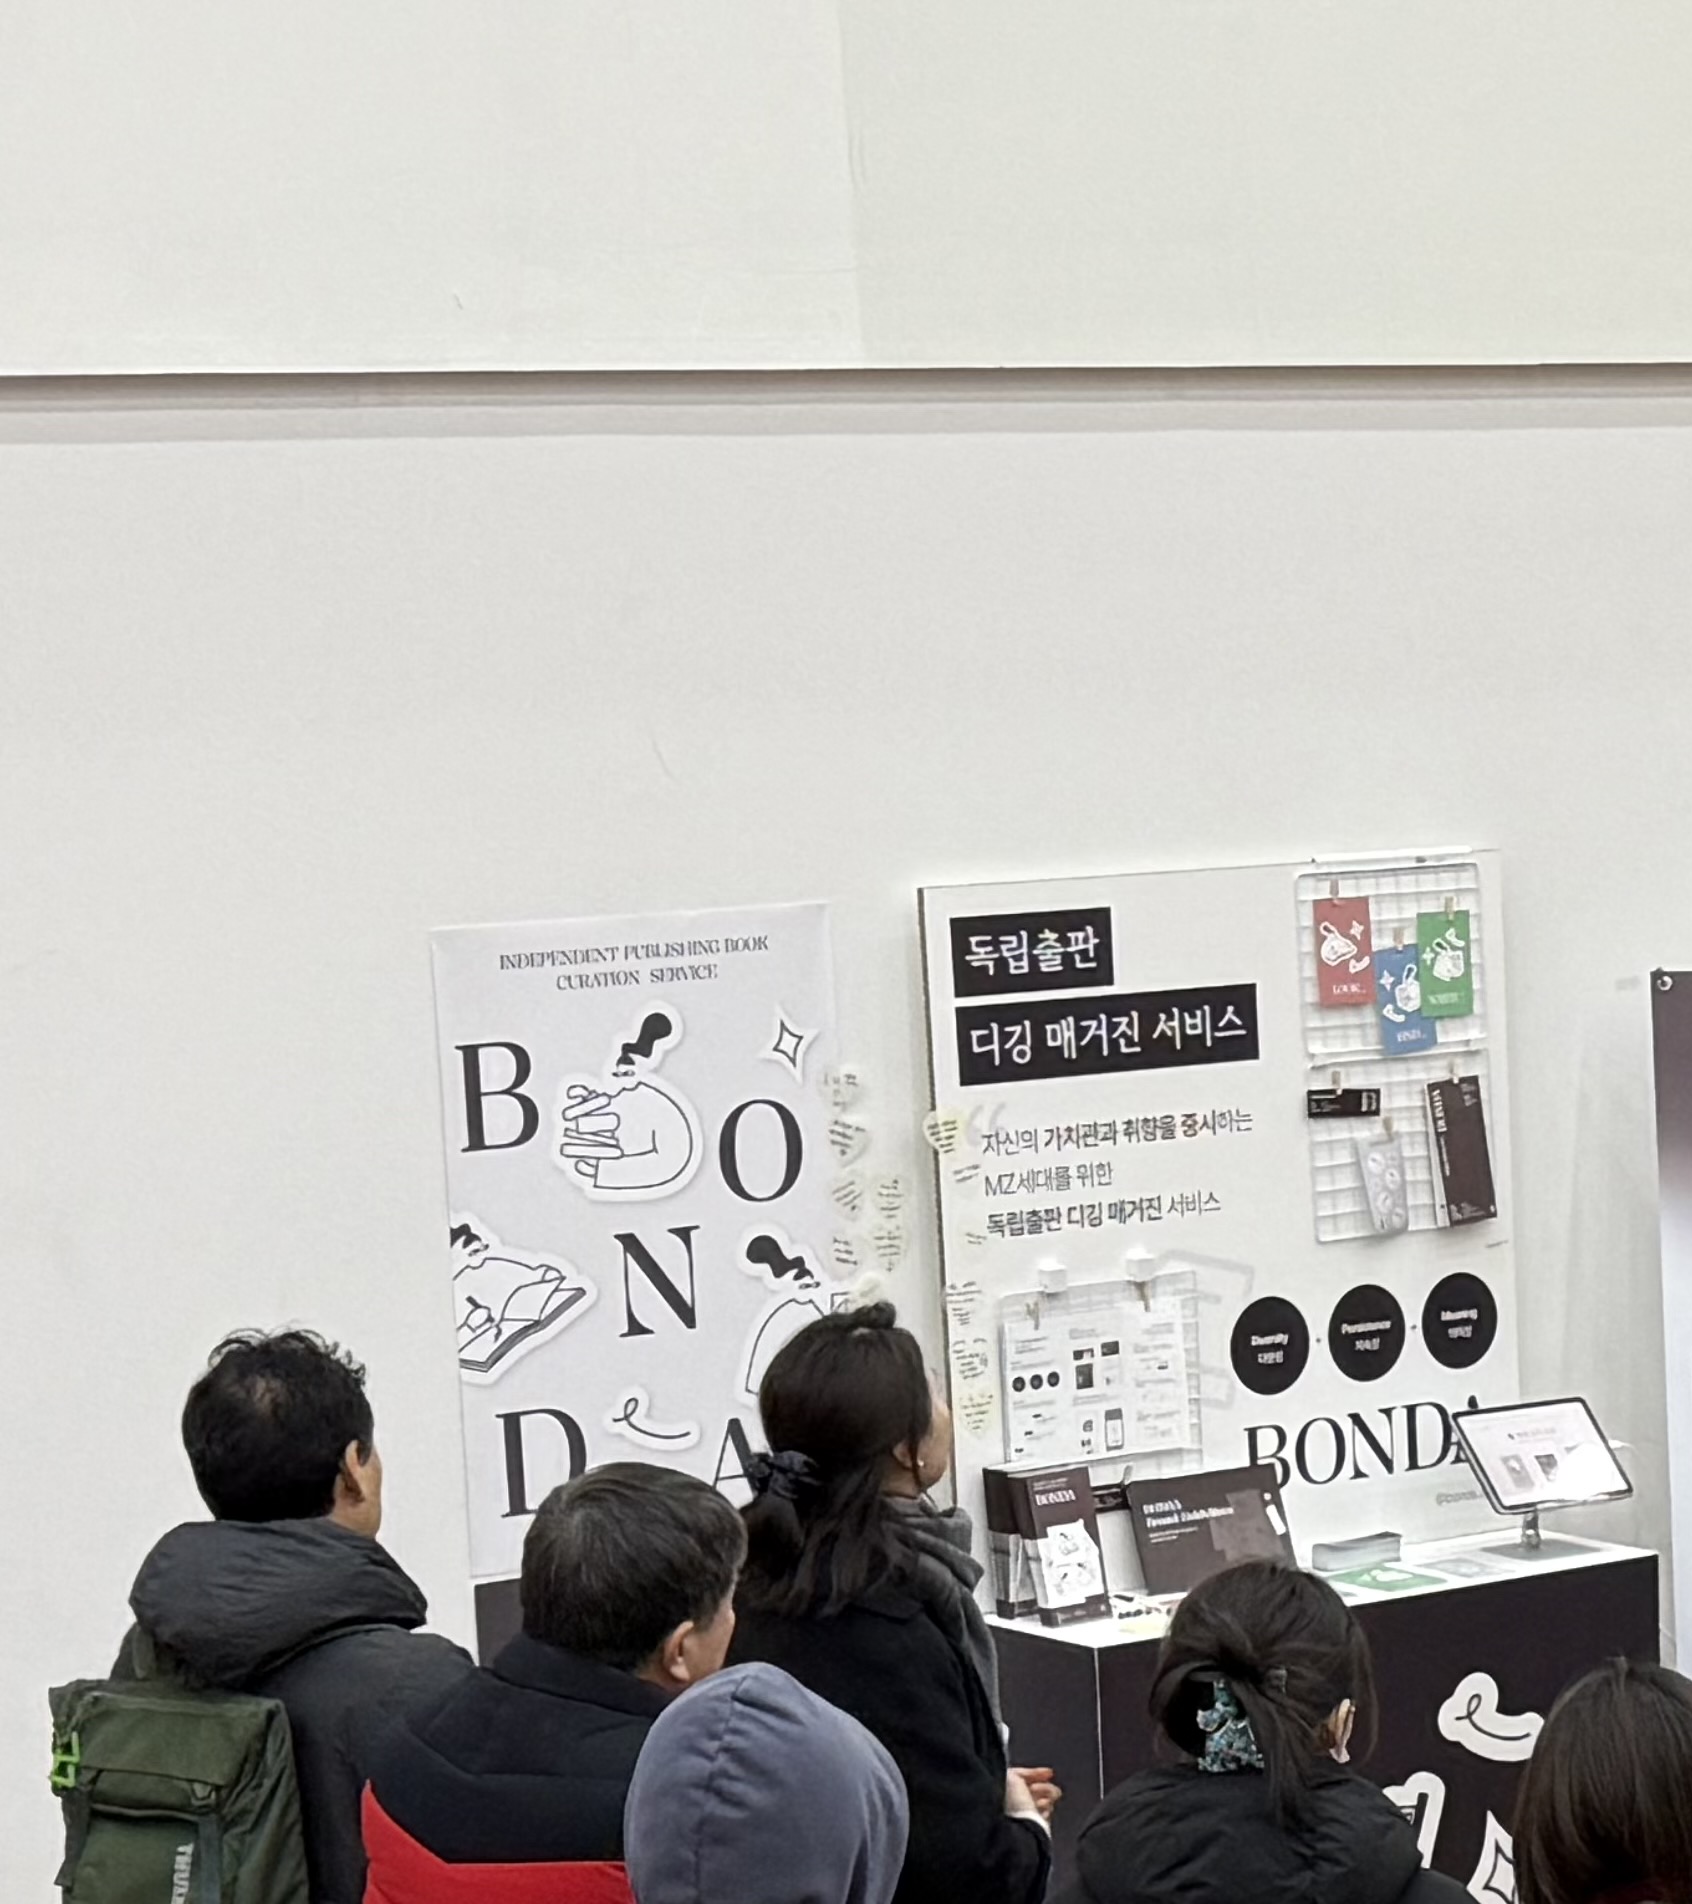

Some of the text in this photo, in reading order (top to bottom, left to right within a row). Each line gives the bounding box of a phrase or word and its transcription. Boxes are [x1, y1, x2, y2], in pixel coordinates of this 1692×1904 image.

[499, 935, 769, 970] INDEPENDENT PUBLISHING BOOK
[964, 925, 1100, 976] 독립출판
[556, 963, 718, 990] CURATION SERVICE
[970, 1004, 1248, 1066] 디깅 매거진 서비스
[454, 1041, 540, 1154] B
[718, 1099, 804, 1203] O
[981, 1108, 1253, 1157] 자신의 가치관과 취향을 중시하는
[984, 1161, 1114, 1197] MZ세대를 위한
[986, 1190, 1222, 1238] 독립출판 디깅 매거진 서비스
[613, 1225, 701, 1338] N
